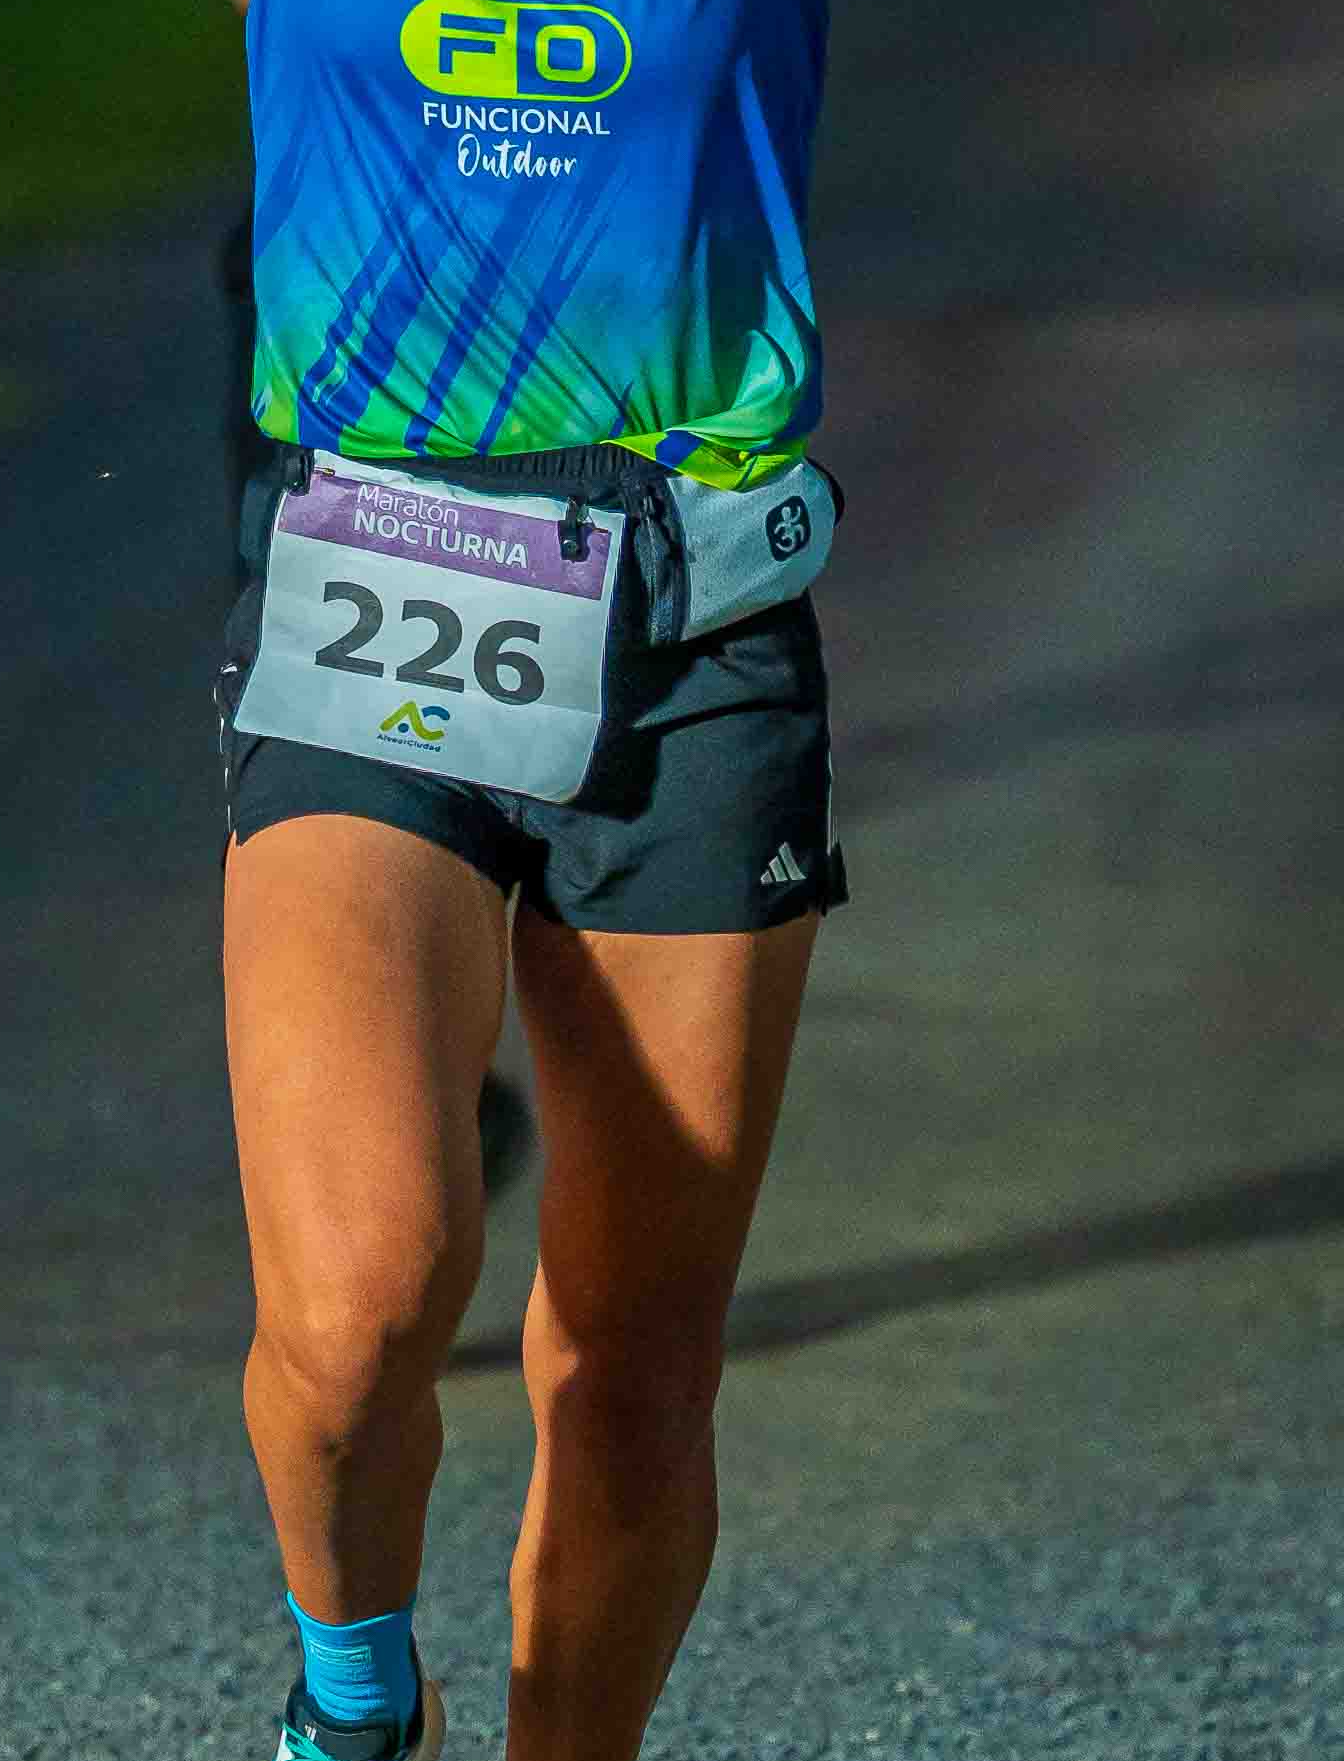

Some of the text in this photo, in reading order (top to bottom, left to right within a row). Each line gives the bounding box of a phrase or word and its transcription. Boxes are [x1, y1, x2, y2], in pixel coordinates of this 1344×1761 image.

[422, 101, 611, 135] FUNCIONAL
[457, 133, 577, 179] Outdoor
[357, 483, 459, 526] Maratón
[353, 507, 528, 569] NOCTURNA
[315, 581, 545, 706] 226
